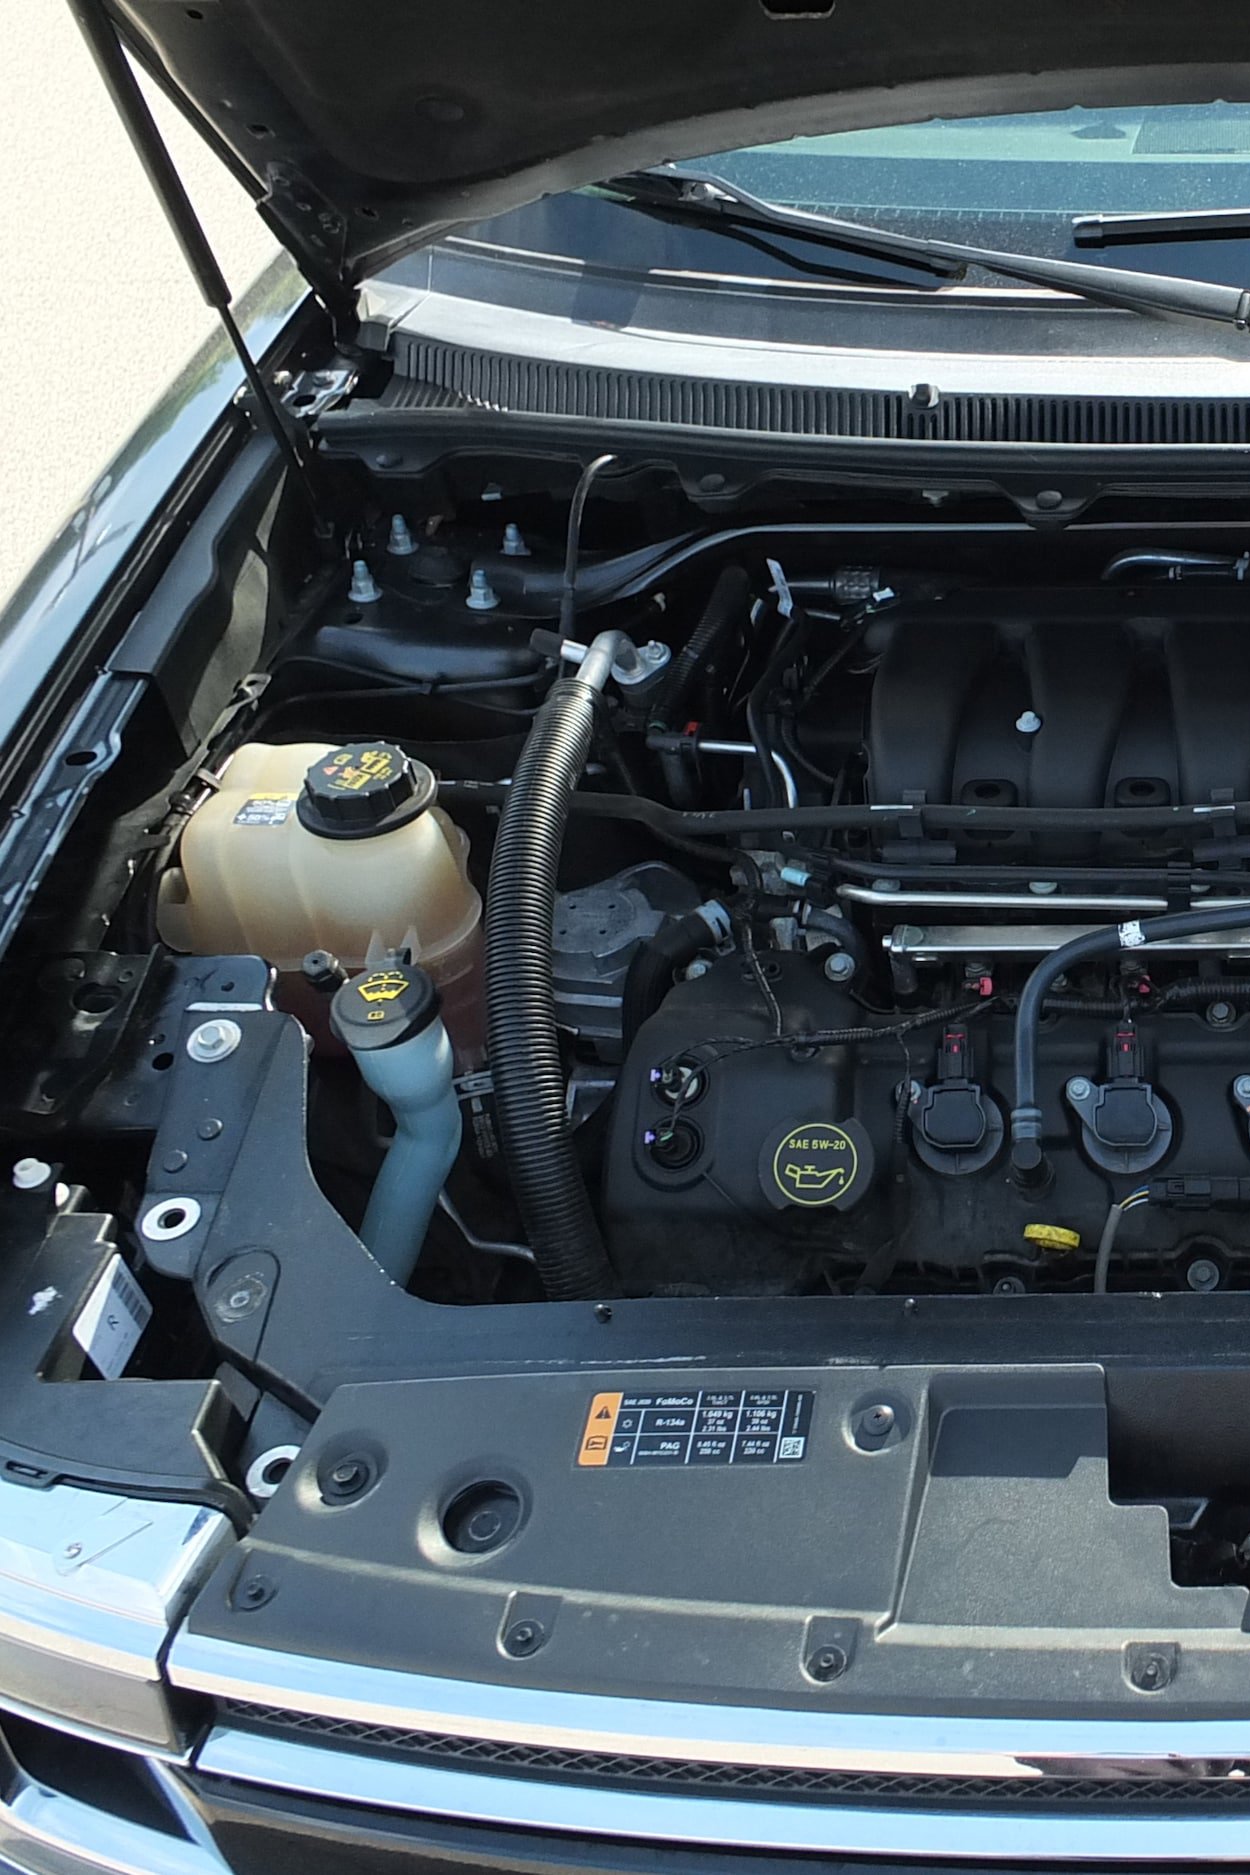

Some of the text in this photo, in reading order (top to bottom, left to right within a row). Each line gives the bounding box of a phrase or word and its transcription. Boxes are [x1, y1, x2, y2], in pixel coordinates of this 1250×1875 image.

[788, 1139, 846, 1150] SAE 5W-20
[655, 1397, 694, 1406] FoMoCo
[655, 1418, 686, 1426] R-134a
[660, 1441, 680, 1450] PAG
